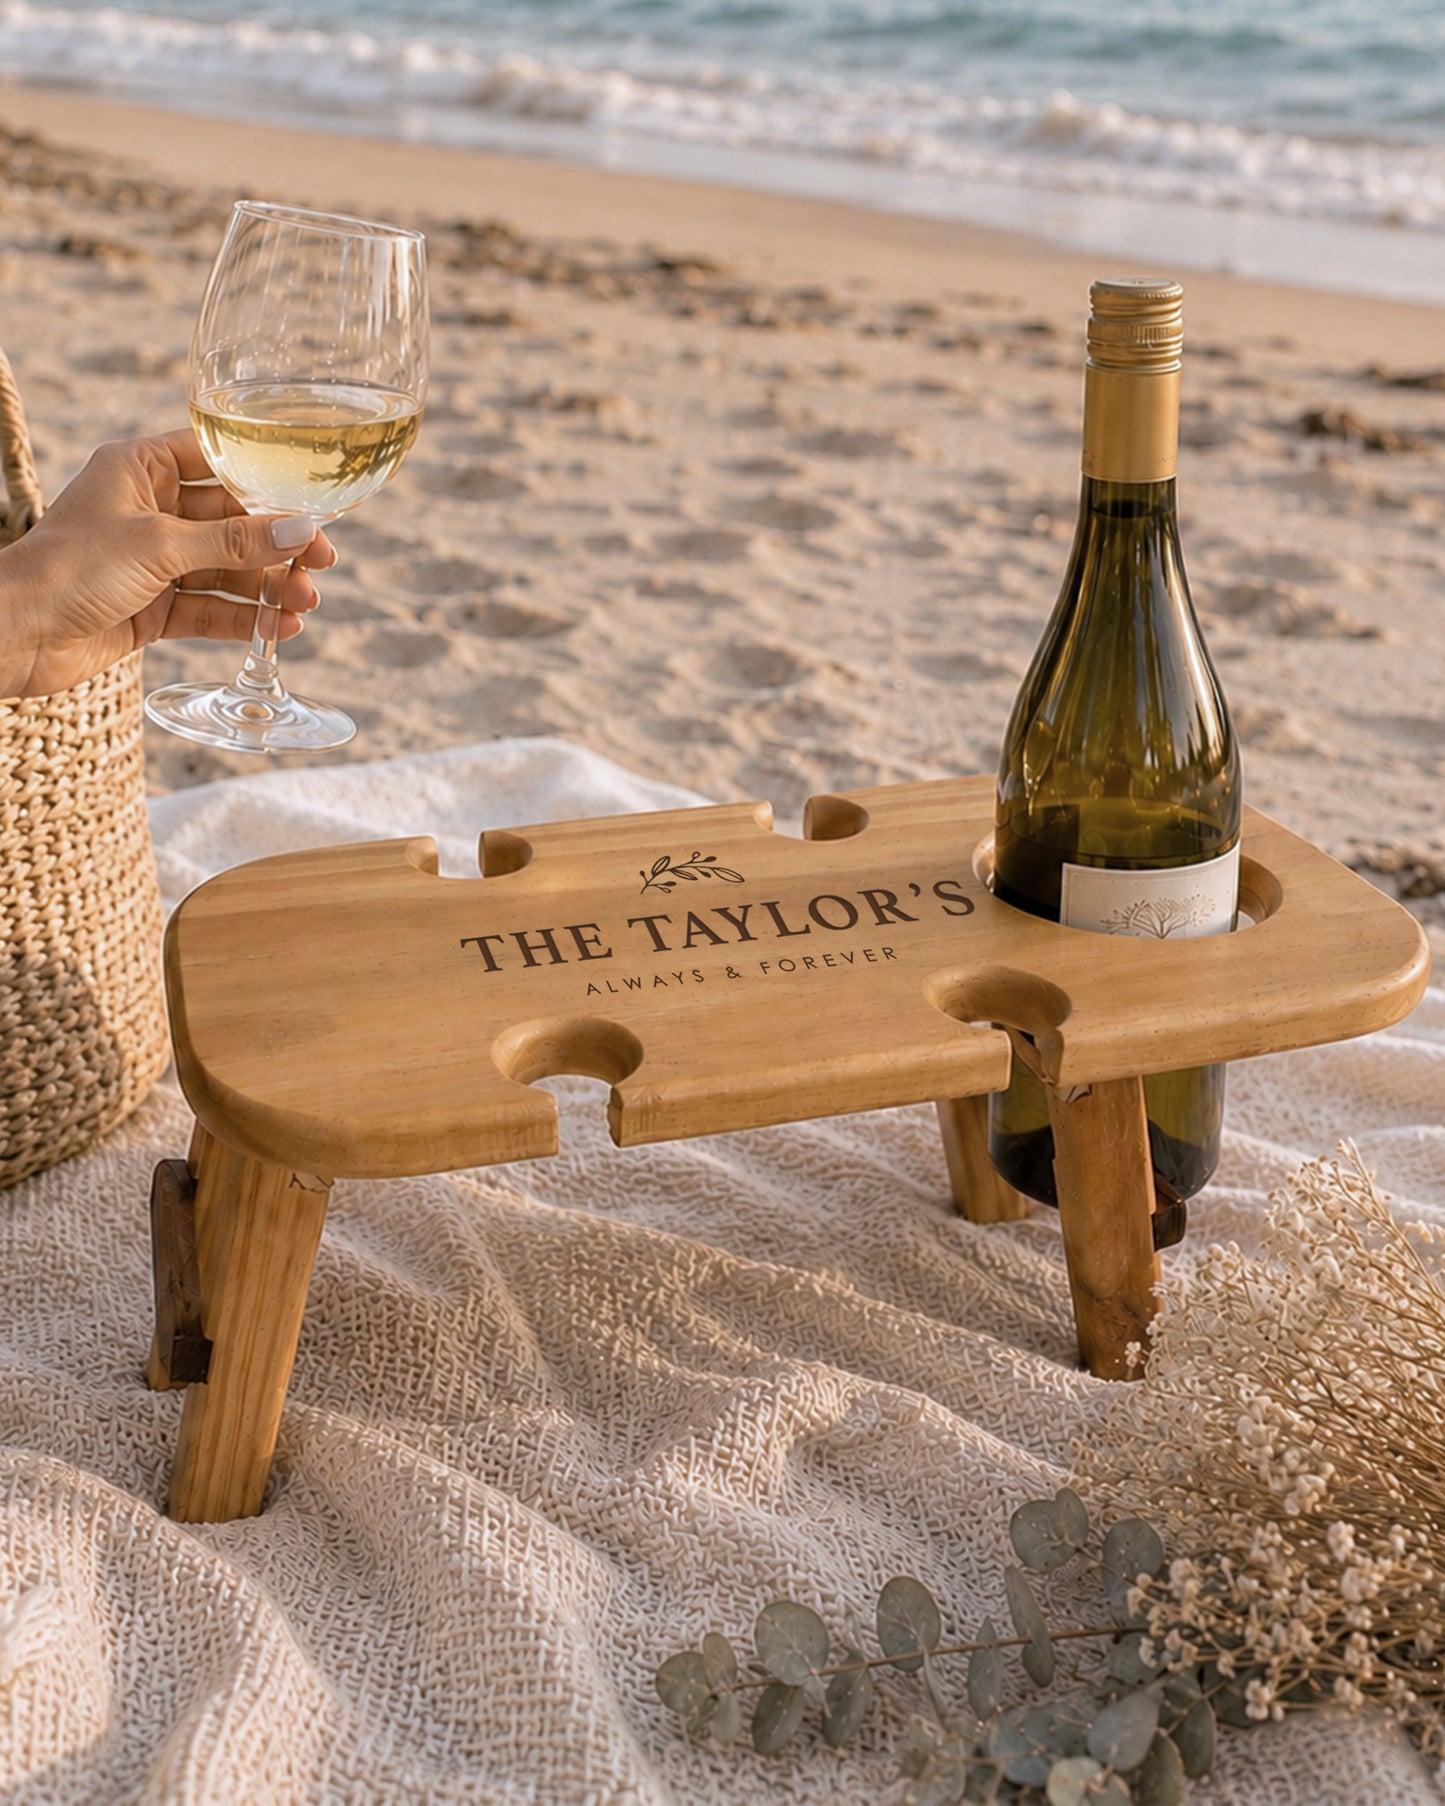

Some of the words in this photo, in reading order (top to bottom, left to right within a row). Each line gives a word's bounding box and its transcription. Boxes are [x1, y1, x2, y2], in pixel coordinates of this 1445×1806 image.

[459, 922, 613, 973] THE
[626, 879, 976, 953] TAYLOR’S
[586, 969, 705, 996] ALWAYS
[725, 965, 743, 980] &
[759, 946, 897, 976] FOREVER
